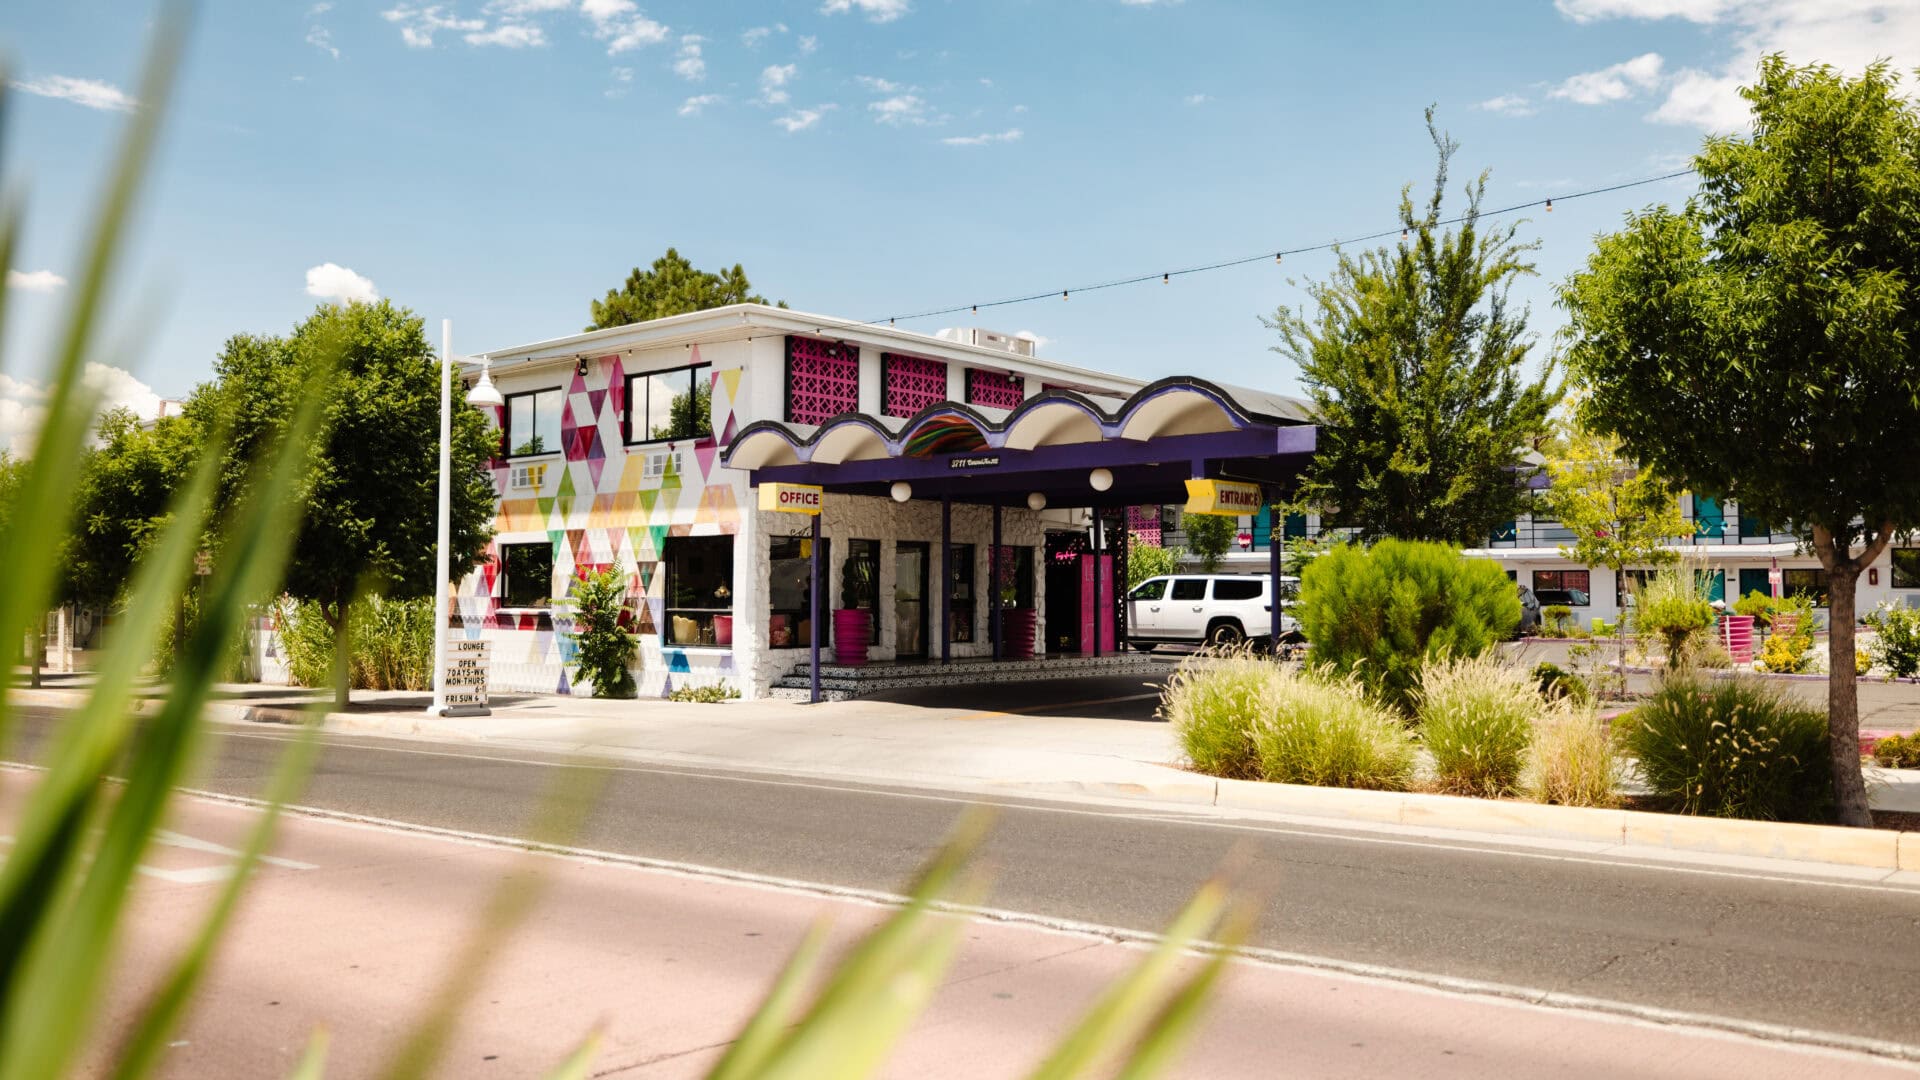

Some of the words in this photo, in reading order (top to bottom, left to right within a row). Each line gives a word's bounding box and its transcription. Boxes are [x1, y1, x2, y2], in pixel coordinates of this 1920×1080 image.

[780, 491, 819, 505] OFFICE
[1220, 490, 1258, 506] ENTRANCE
[459, 660, 476, 668] OPEN
